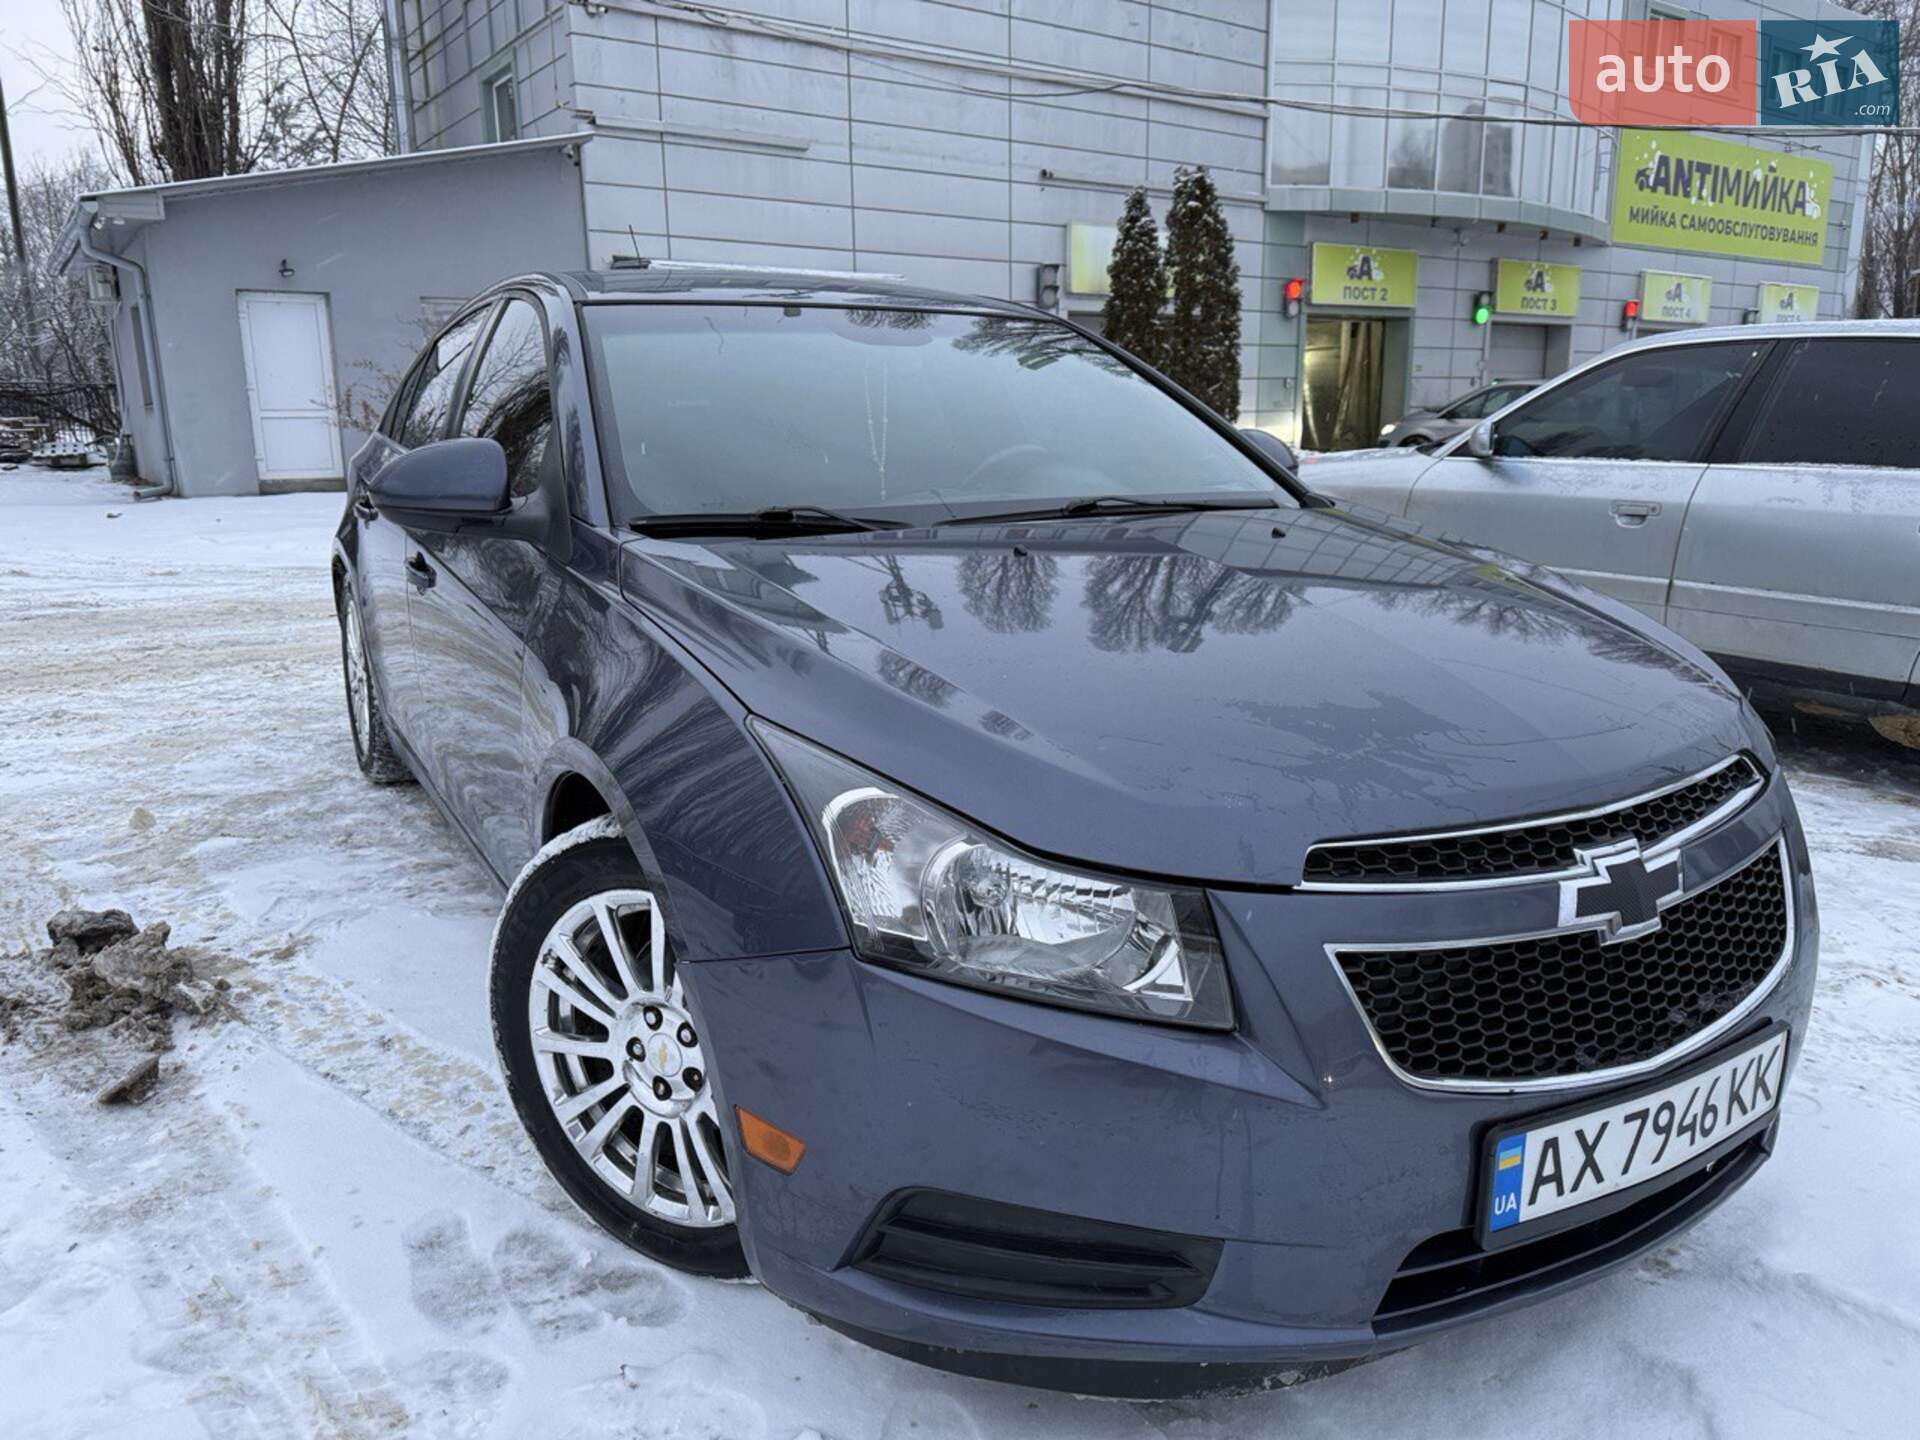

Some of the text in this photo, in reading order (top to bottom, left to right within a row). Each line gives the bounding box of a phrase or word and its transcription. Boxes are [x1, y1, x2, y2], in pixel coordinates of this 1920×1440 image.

[1628, 204, 1819, 247] МИЙКА САМООБСЛУГОВУВАННЯ
[1343, 285, 1388, 301] ПОСТ 2
[1521, 296, 1557, 311] ПОСТ 3
[1528, 1045, 1781, 1206] AX 7946 KK
[1494, 1191, 1518, 1216] UA
